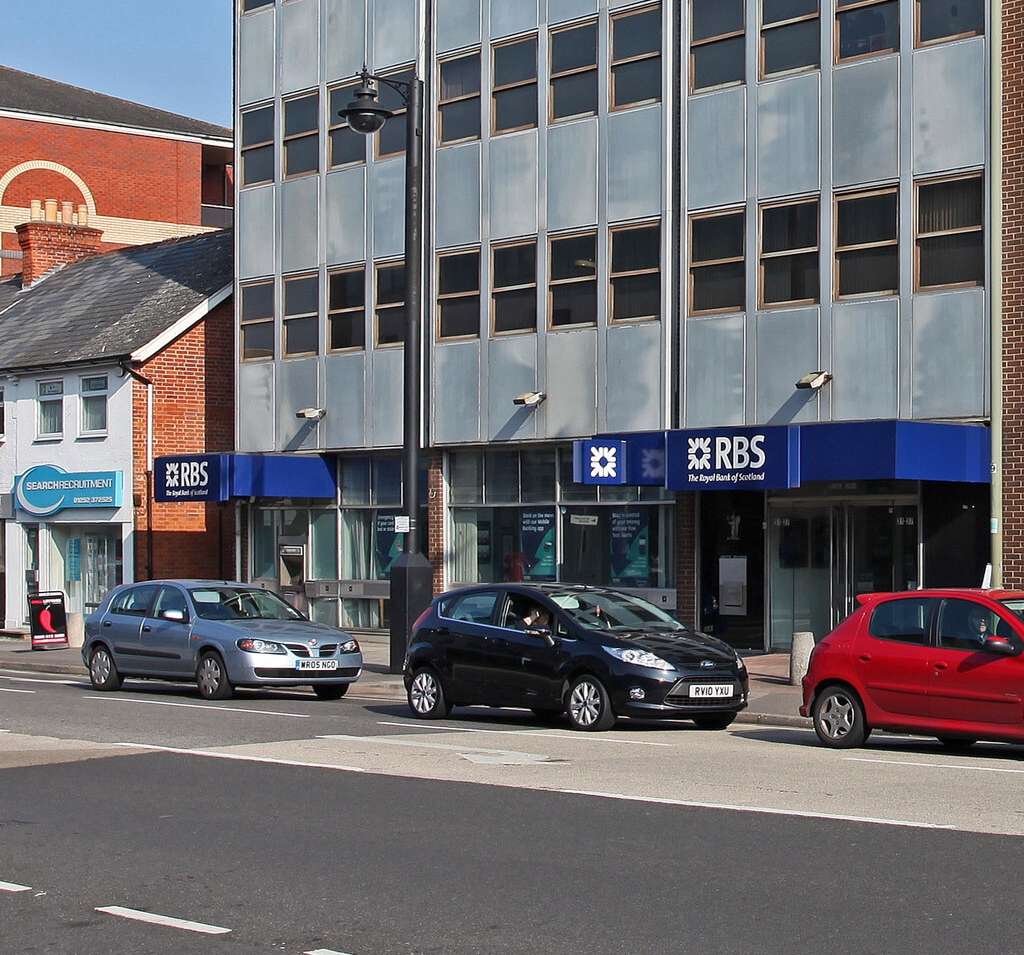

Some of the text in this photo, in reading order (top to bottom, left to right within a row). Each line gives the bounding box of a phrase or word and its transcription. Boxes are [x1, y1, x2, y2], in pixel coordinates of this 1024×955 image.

[715, 435, 766, 469] RBS
[181, 461, 209, 487] RBS
[688, 472, 765, 483] The Royal Bank of Scotland
[694, 686, 730, 696] RV10 YXU
